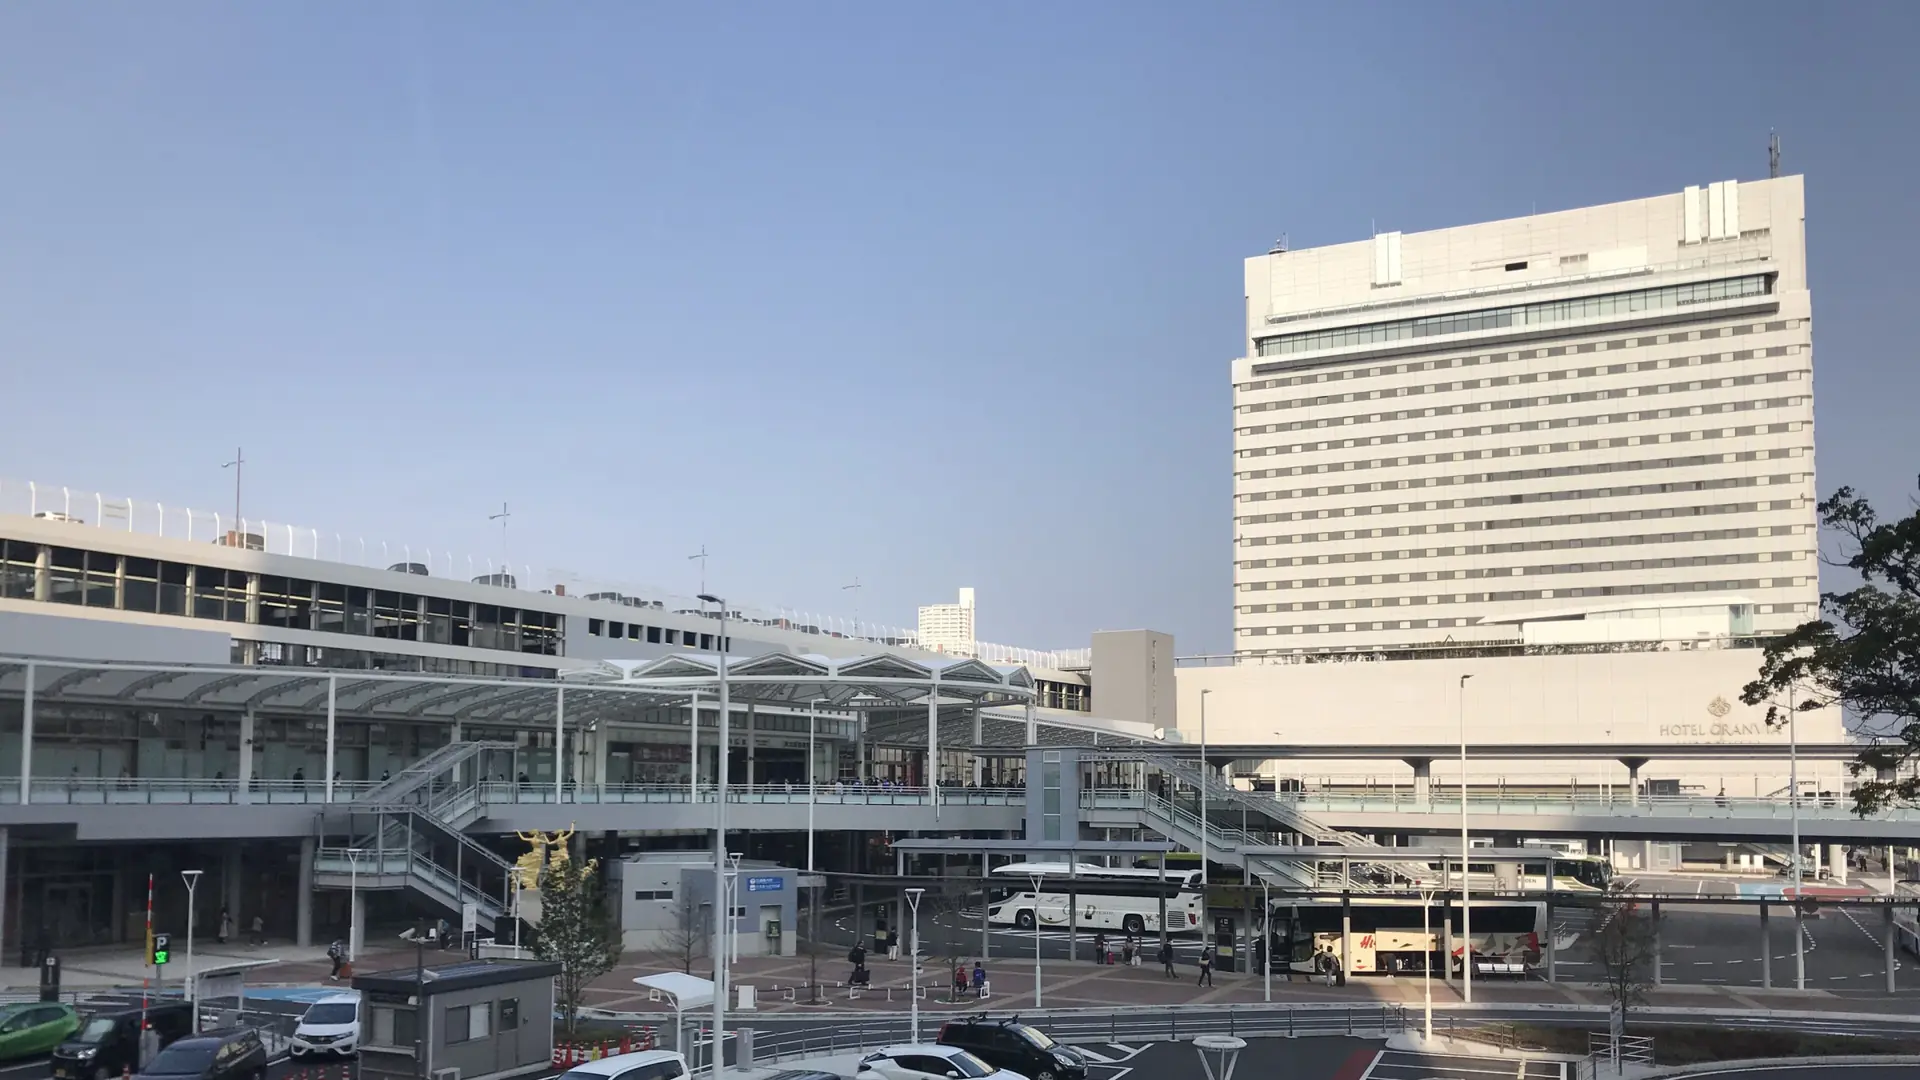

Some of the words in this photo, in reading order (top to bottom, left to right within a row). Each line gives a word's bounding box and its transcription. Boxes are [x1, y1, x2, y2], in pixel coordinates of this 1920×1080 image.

[1660, 724, 1705, 736] HOTEL
[156, 936, 167, 950] P
[1360, 935, 1376, 949] Hi
